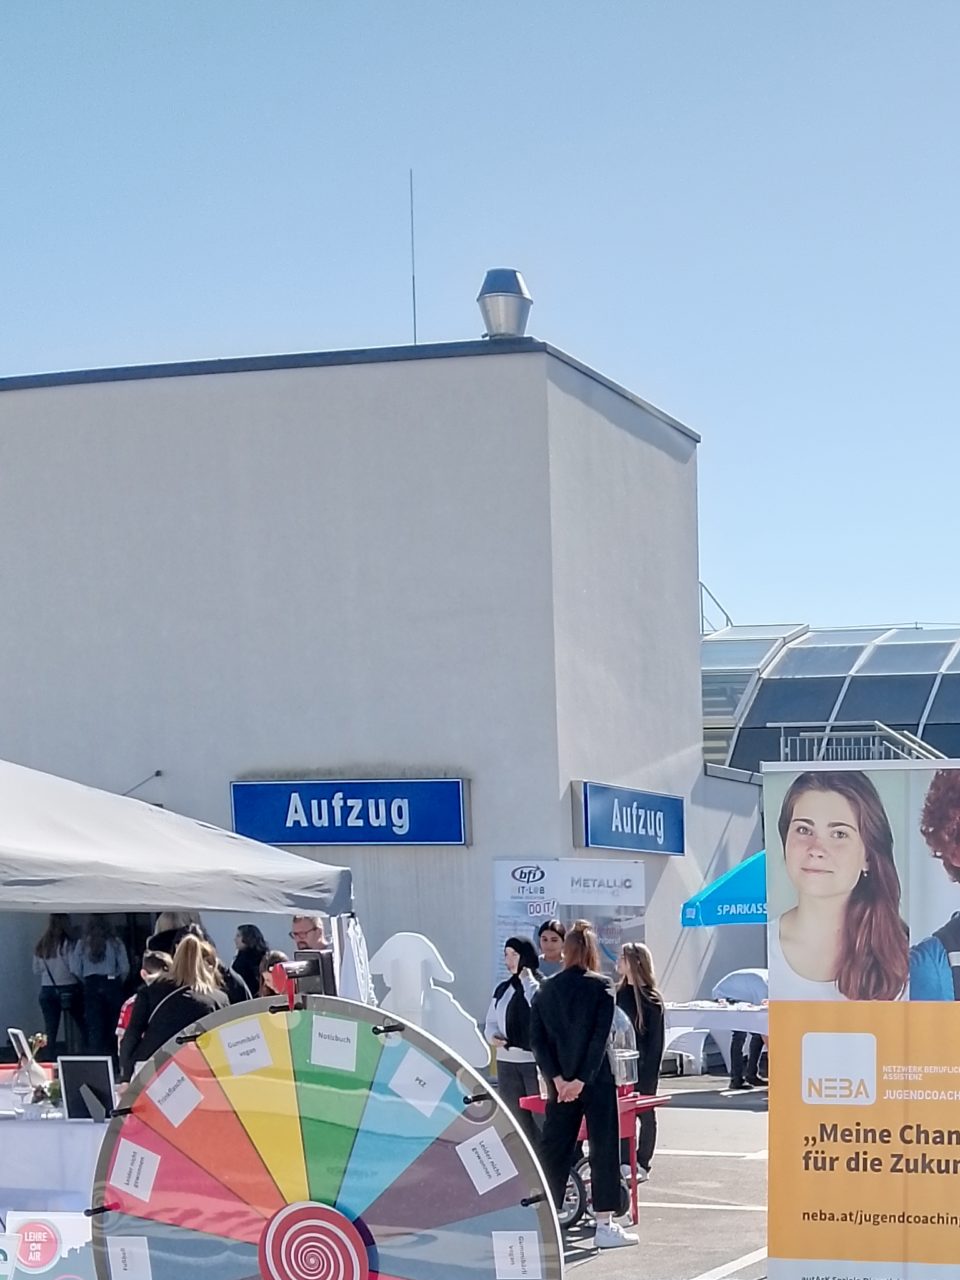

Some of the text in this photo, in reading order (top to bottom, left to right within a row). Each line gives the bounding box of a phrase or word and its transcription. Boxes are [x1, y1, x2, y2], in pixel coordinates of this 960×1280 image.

[285, 792, 410, 835] Aufzug
[611, 798, 664, 845] Aufzug
[519, 869, 536, 884] bfi
[571, 876, 633, 889] METALLIC
[529, 900, 556, 915] DO IT!
[717, 903, 768, 915] SPARKASS
[239, 1047, 256, 1058] vegan
[882, 1065, 924, 1074] NETZWERK
[414, 1076, 427, 1088] PEZ
[882, 1073, 923, 1081] ASSISTENZ
[808, 1077, 870, 1099] NEBA
[471, 1147, 493, 1180] gewonnen
[478, 1140, 502, 1178] Leider nicht
[802, 1150, 839, 1171] für
[846, 1151, 883, 1173] die
[24, 1231, 48, 1242] LEHRE
[28, 1252, 42, 1261] AIR
